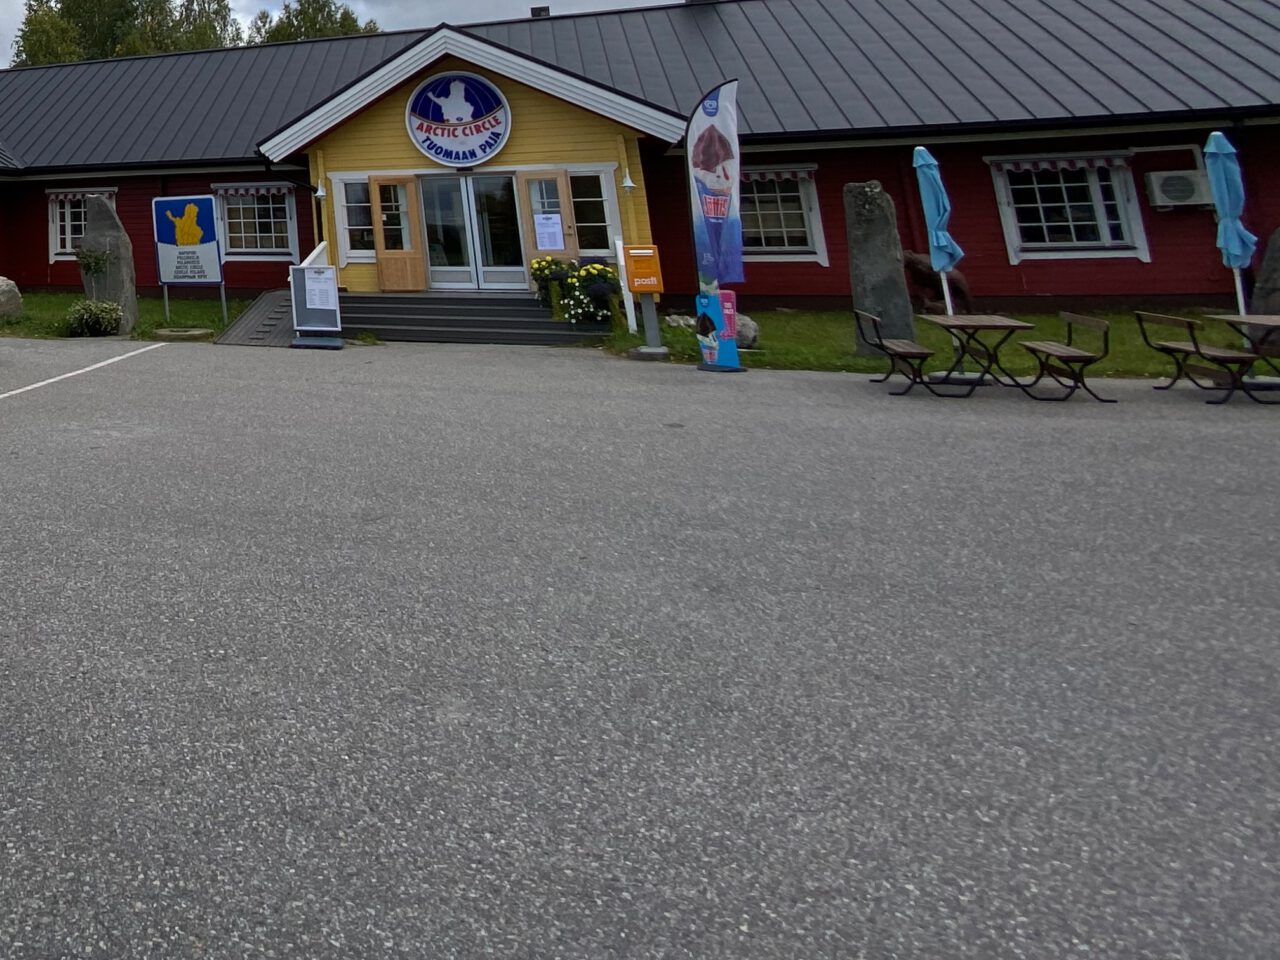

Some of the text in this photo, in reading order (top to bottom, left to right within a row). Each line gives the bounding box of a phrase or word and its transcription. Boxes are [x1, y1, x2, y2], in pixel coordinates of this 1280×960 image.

[416, 115, 502, 138] ARCTIC CIRCLE
[421, 131, 502, 161] TUOMAAN PAJA
